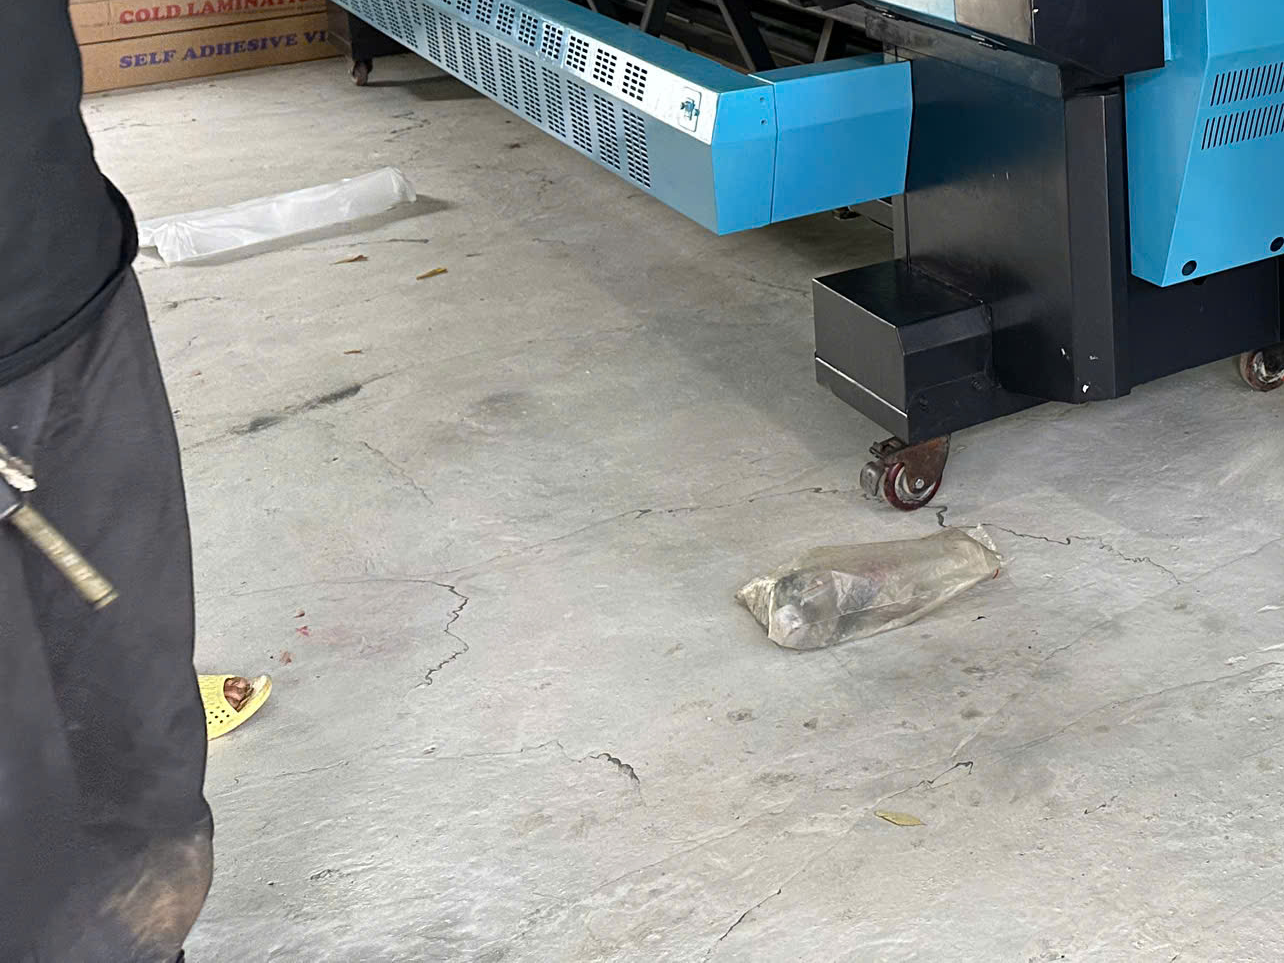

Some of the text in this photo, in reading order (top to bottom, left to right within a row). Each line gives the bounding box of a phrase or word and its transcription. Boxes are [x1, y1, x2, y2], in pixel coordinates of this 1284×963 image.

[119, 4, 182, 24] COLD
[119, 49, 177, 68] SELF
[183, 33, 298, 61] ADHESIVE
